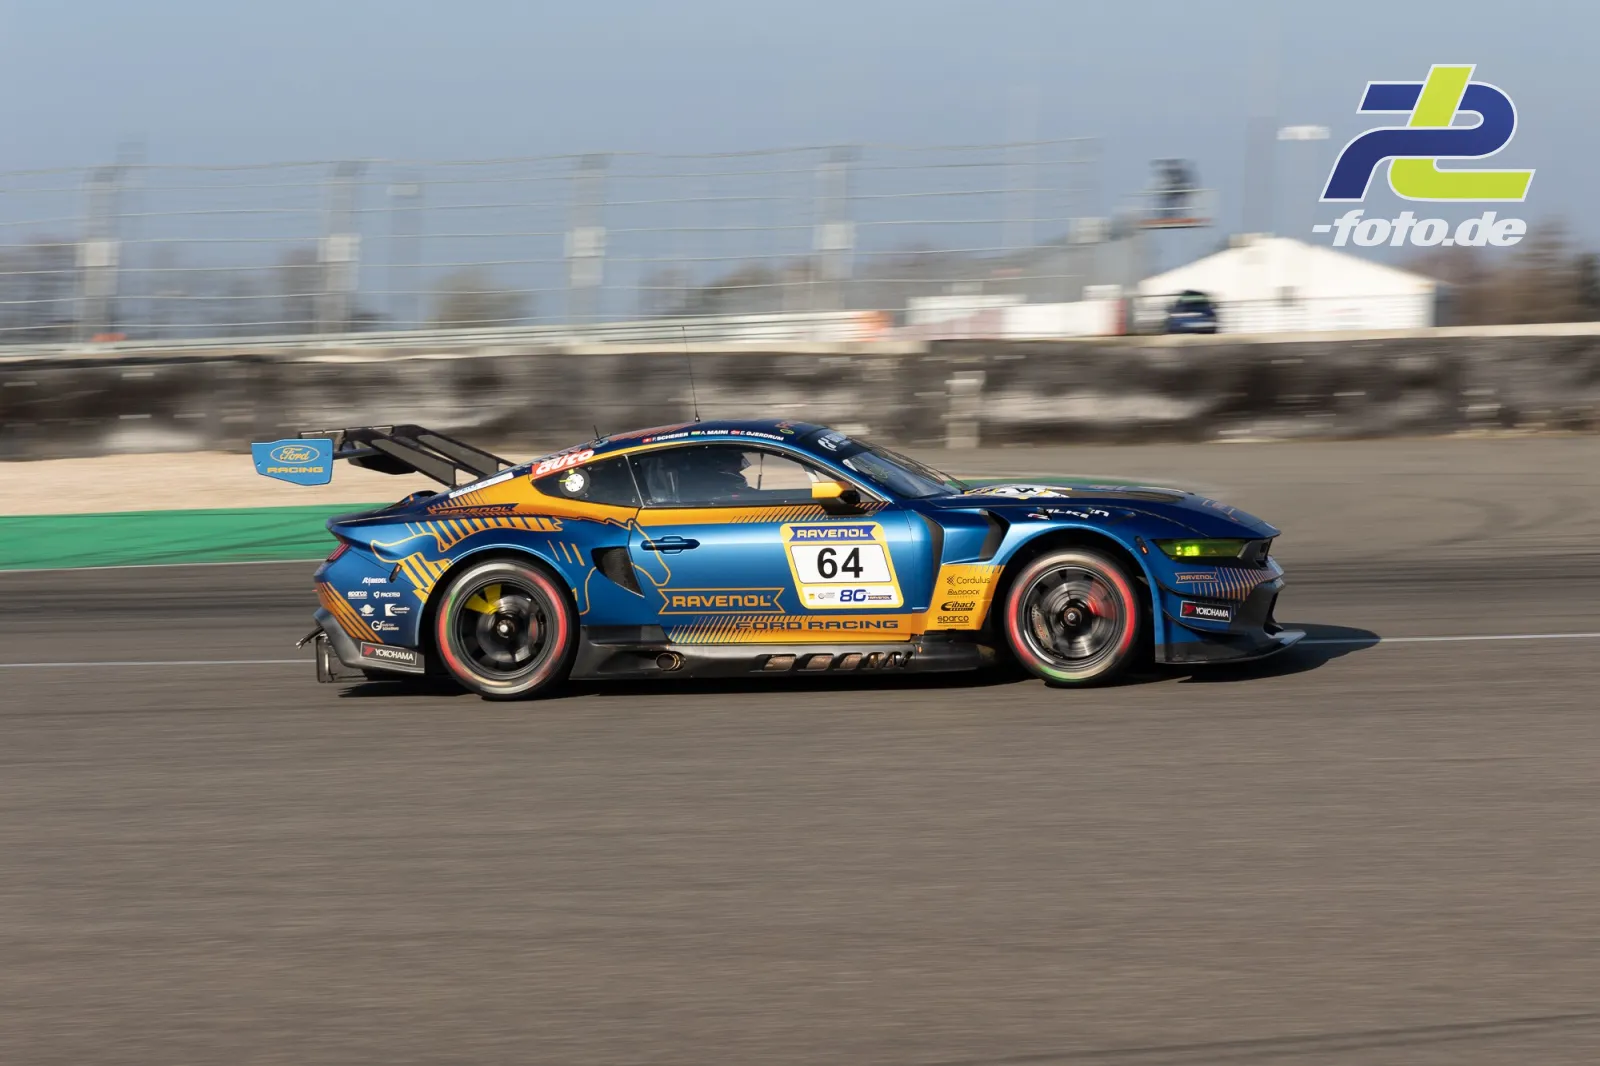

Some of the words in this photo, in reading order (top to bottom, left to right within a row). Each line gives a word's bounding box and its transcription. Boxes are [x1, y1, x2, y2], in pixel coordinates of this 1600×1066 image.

[280, 447, 311, 461] Ford
[536, 450, 595, 475] auto
[267, 466, 324, 474] RACING
[797, 528, 869, 539] RAVENOL
[817, 547, 864, 579] 64
[956, 576, 991, 585] Cordulus
[672, 595, 771, 608] RAVENOL
[840, 589, 867, 602] 80
[1195, 606, 1229, 618] YOKOHAMA
[735, 621, 803, 630] FORD
[808, 620, 898, 630] RACING
[937, 615, 970, 623] sparco
[375, 648, 414, 661] YOKOHAMA
